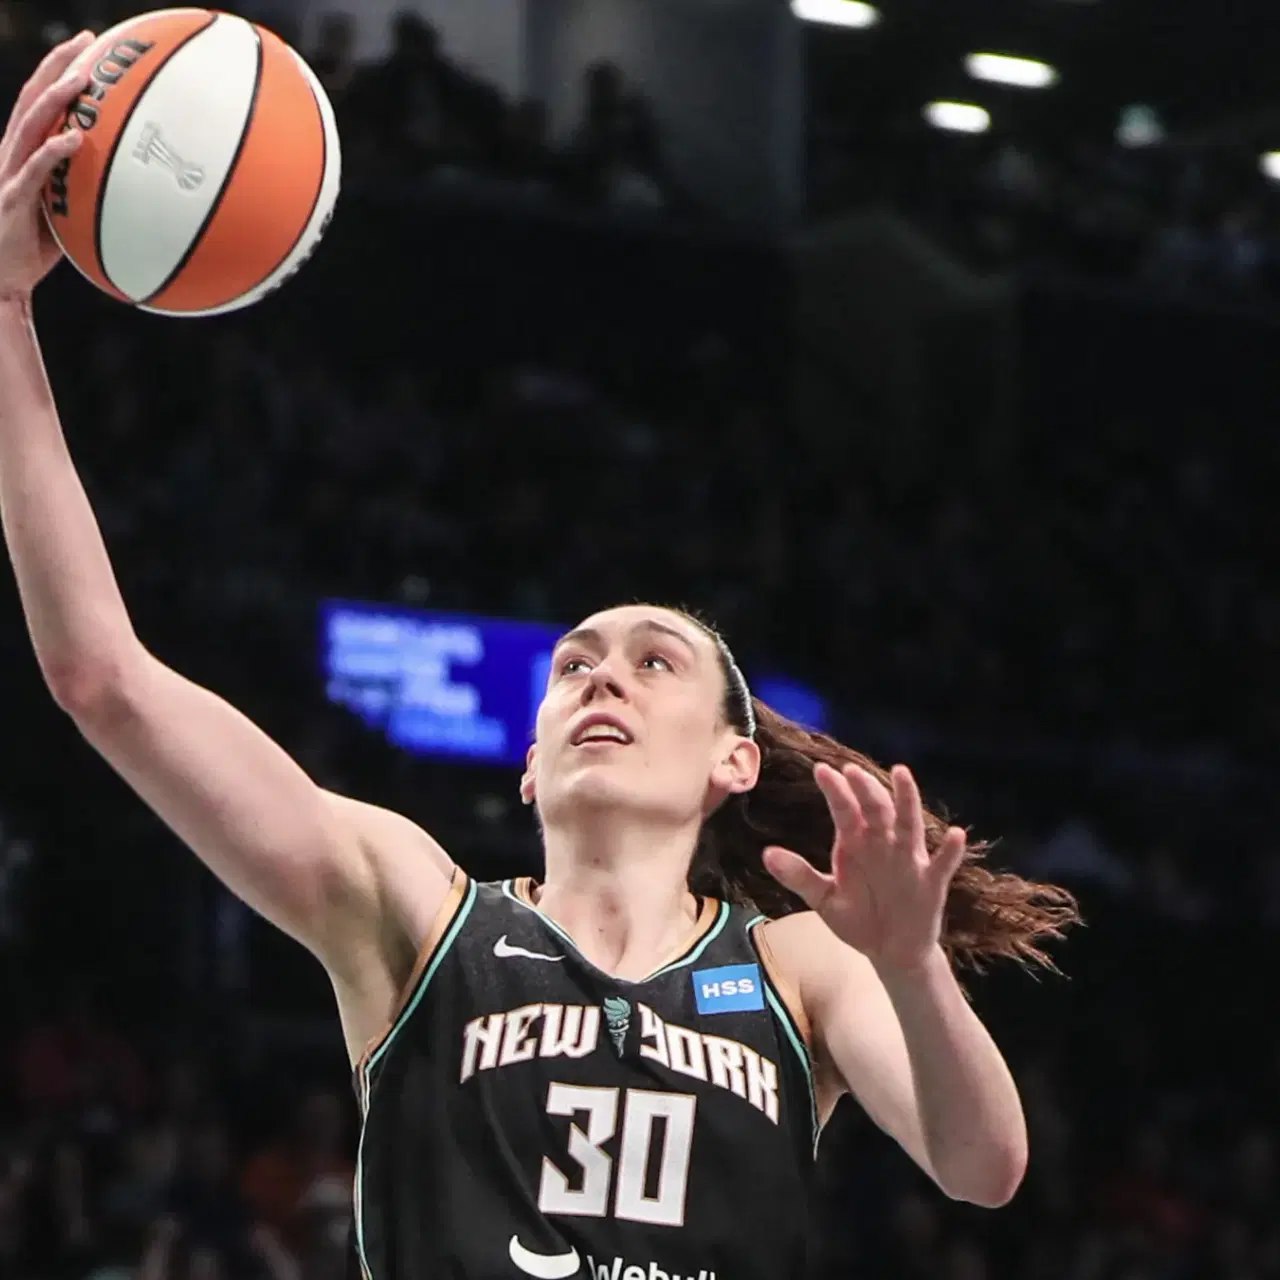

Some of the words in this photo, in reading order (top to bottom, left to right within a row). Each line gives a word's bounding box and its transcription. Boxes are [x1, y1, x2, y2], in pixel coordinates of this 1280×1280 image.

[702, 978, 755, 999] HSS
[460, 1002, 600, 1083] NEW
[637, 1002, 778, 1126] YORK
[538, 1081, 697, 1227] 30
